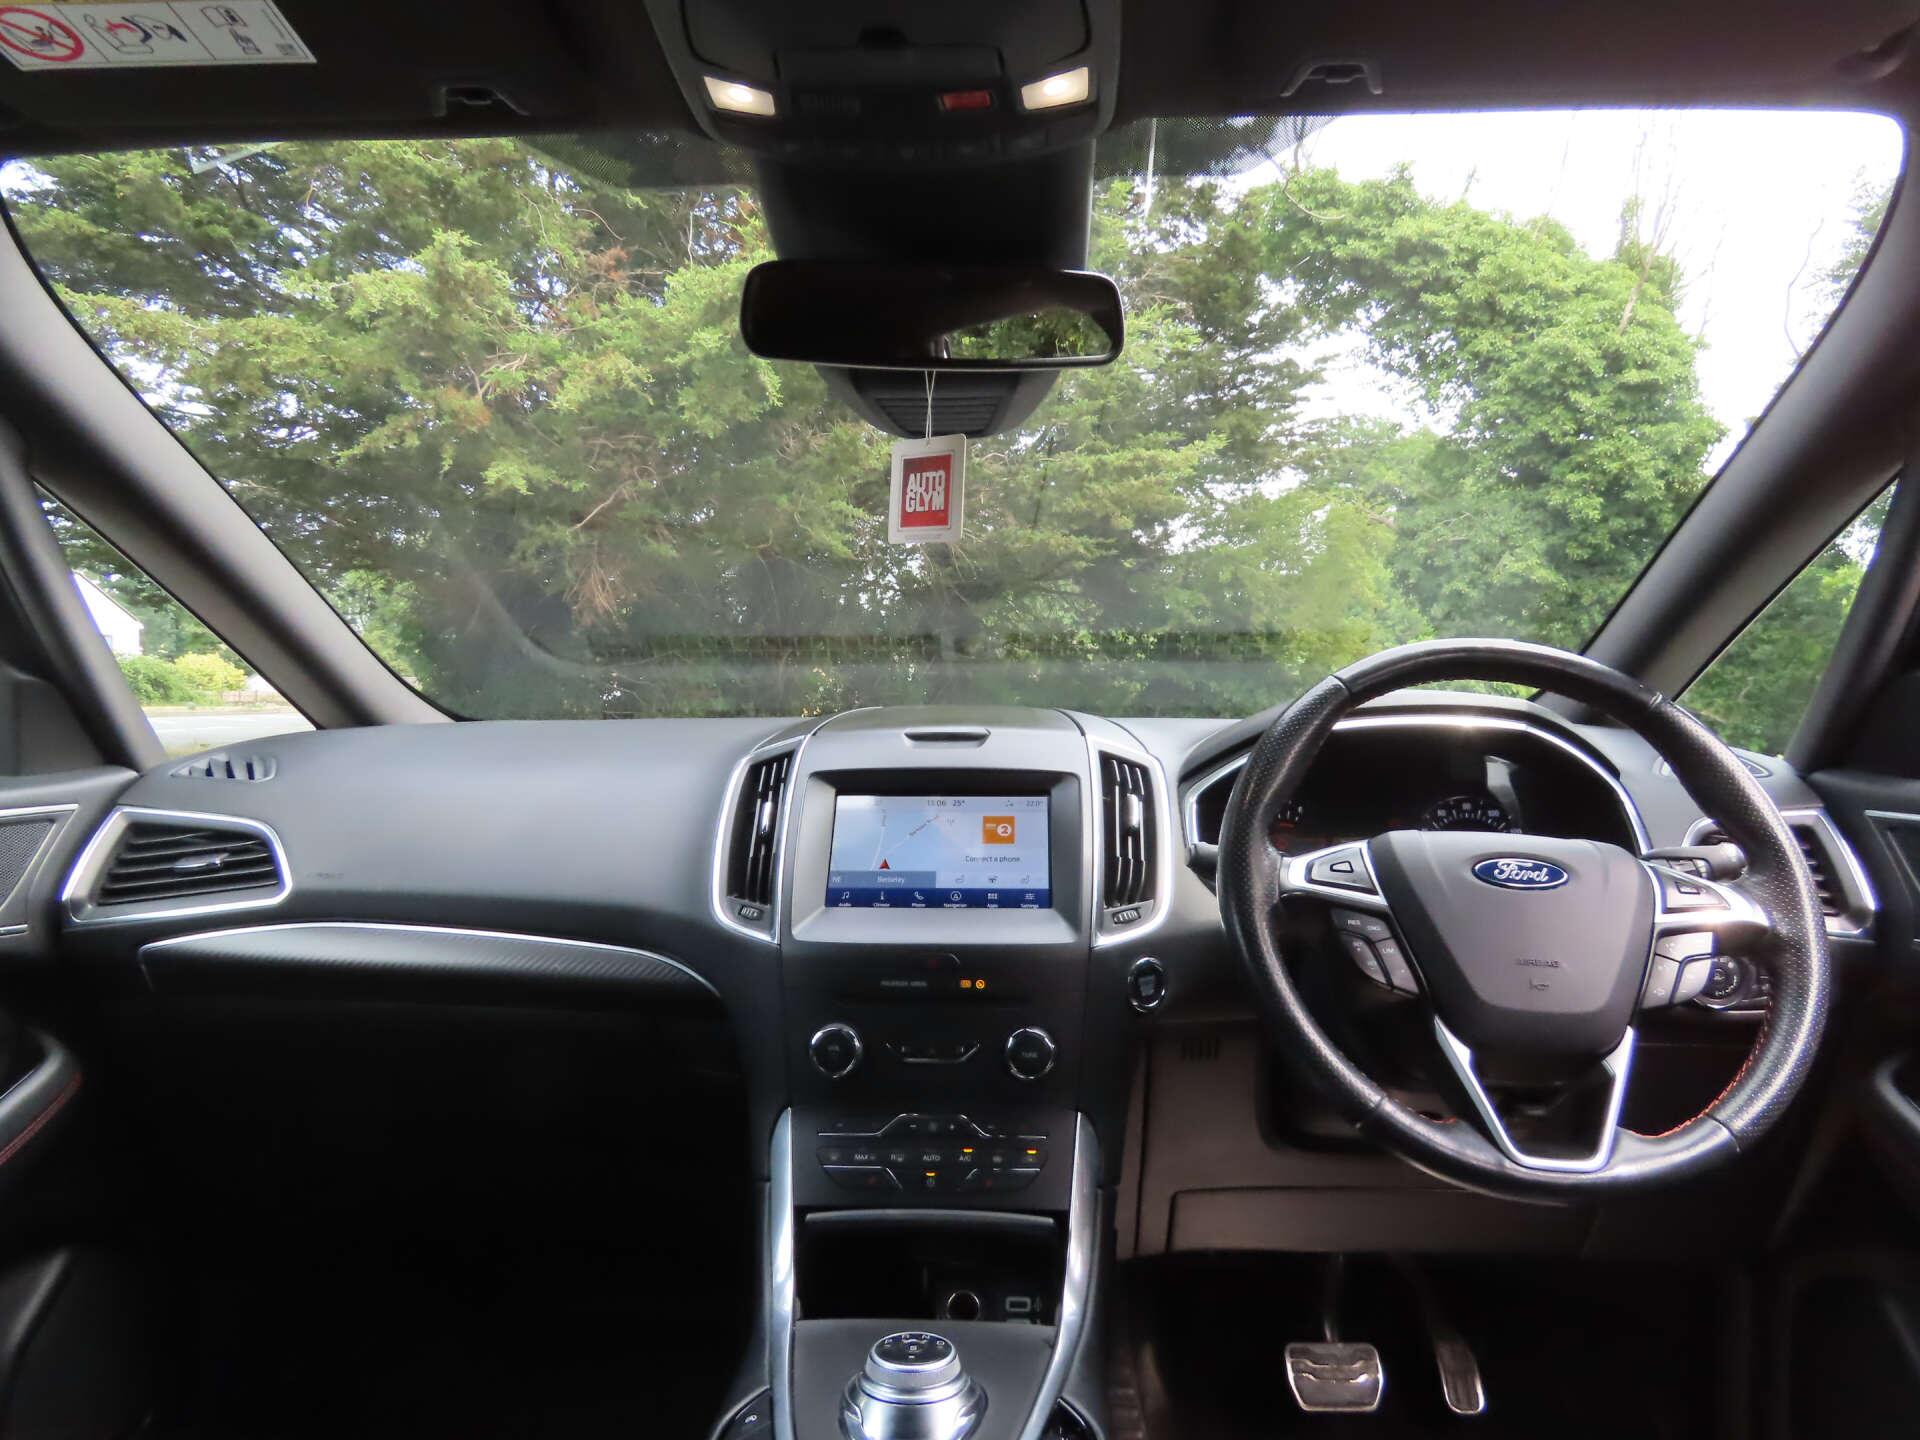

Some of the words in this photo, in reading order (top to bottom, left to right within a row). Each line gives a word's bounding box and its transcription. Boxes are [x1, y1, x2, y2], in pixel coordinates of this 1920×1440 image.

[906, 470, 946, 492] AUTO
[905, 489, 945, 512] GLYM
[999, 855, 1021, 864] phone
[1493, 860, 1549, 881] Ford
